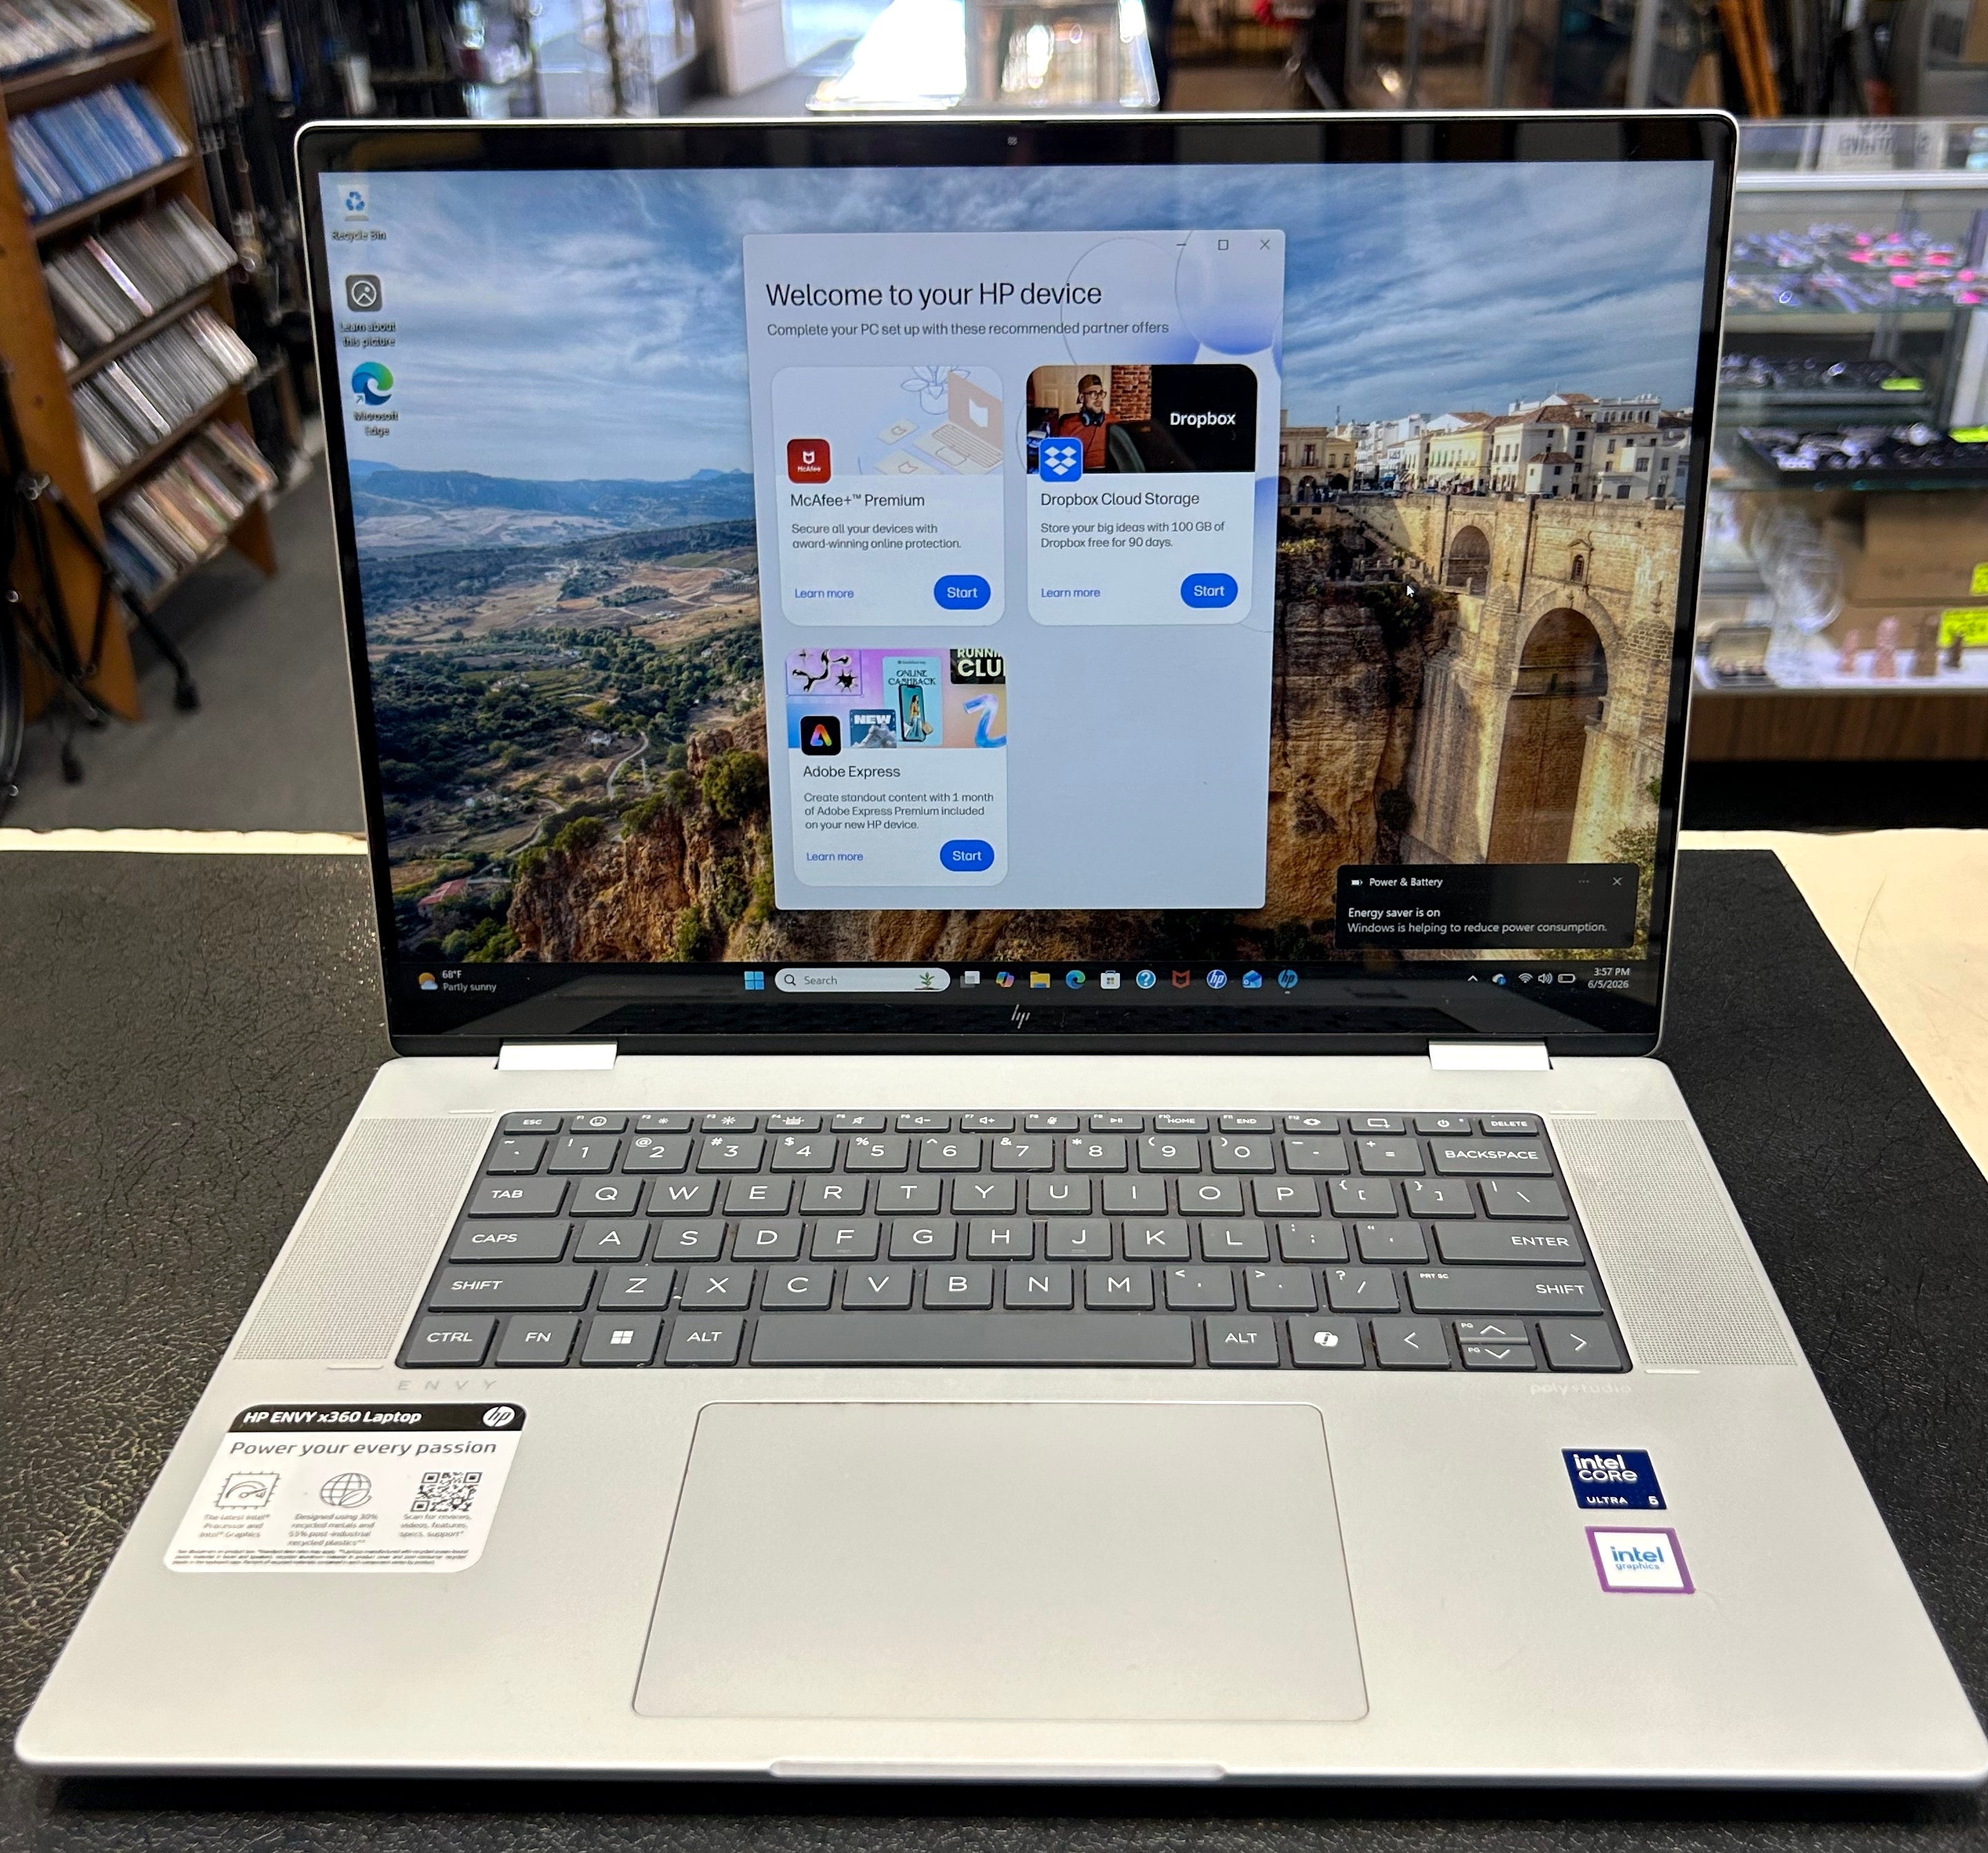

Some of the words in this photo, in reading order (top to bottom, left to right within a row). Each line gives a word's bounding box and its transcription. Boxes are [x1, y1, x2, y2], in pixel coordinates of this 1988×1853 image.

[766, 284, 882, 306] Welcome
[889, 285, 912, 305] to
[918, 288, 973, 310] your
[981, 283, 1014, 304] HP
[1021, 282, 1101, 304] device
[340, 323, 366, 333] Learn
[368, 323, 395, 332] about
[767, 324, 828, 337] Complete
[831, 326, 858, 337] your
[861, 324, 878, 335] PC
[882, 324, 900, 335] set
[904, 326, 920, 337] up
[923, 323, 947, 334] with
[952, 323, 986, 334] these
[989, 322, 1079, 334] recommended
[1083, 323, 1130, 335] partner
[1132, 322, 1169, 333] offers
[343, 337, 360, 347] this
[362, 337, 395, 349] picture
[353, 411, 398, 421] Microsoft
[1170, 411, 1236, 428] Dropbox
[365, 427, 389, 438] Edge
[865, 494, 924, 506] Premium
[1041, 493, 1098, 508] Dropbox
[1101, 493, 1141, 505] Cloud
[1145, 493, 1199, 507] Storage
[791, 524, 829, 533] Secure
[832, 524, 845, 533] all
[847, 526, 870, 536] your
[873, 524, 914, 533] devices
[916, 524, 938, 533] with
[1041, 523, 1070, 533] Store
[1072, 525, 1095, 534] your
[1098, 523, 1113, 535] big
[1116, 522, 1145, 532] ideas
[1148, 522, 1169, 531] with
[1172, 522, 1193, 531] 100
[1196, 522, 1212, 531] GB
[1214, 521, 1225, 531] of
[793, 539, 869, 551] award-winning
[871, 538, 903, 549] online
[905, 539, 961, 550] protection.
[1041, 538, 1085, 549] Dropbox
[1088, 538, 1109, 547] free
[1112, 538, 1126, 547] for
[1129, 538, 1143, 547] 90
[1145, 538, 1172, 549] days.
[795, 589, 825, 598] Learn
[947, 587, 978, 598] Start
[1041, 589, 1071, 598] Learn
[1194, 585, 1225, 596] Start
[958, 659, 1005, 676] CLU
[854, 714, 891, 724] NEW
[804, 766, 845, 777] Adobe
[849, 766, 900, 779] Express
[804, 793, 838, 802] Create
[841, 793, 886, 802] standout
[889, 794, 927, 802] content
[929, 793, 950, 801] with
[953, 793, 958, 801] 1
[962, 793, 994, 801] month
[805, 807, 814, 815] of
[818, 806, 849, 815] Adobe
[852, 807, 892, 817] Express
[895, 807, 939, 815] Premium
[941, 806, 984, 815] included
[820, 823, 842, 831] your
[867, 820, 881, 828] HP
[884, 821, 918, 829] device.
[807, 852, 835, 861] Learn
[953, 851, 982, 861] Start
[1370, 878, 1397, 886] Power
[1400, 878, 1407, 886] &
[1411, 878, 1443, 888] Battery
[1349, 908, 1384, 919] Energy
[1416, 908, 1424, 917] is
[1348, 923, 1395, 932] Windows
[1398, 923, 1406, 932] is
[1408, 923, 1447, 934] helping
[1464, 923, 1499, 932] reduce
[1502, 925, 1535, 934] power
[1537, 922, 1606, 933] consumption.
[442, 970, 462, 979] 68°F
[1594, 968, 1613, 976] 3:57
[805, 976, 837, 985] Search
[1210, 970, 1224, 988] hp
[1588, 980, 1628, 988] 6/5/2026
[443, 983, 468, 992] Partly
[470, 984, 497, 992] sunny
[1445, 1150, 1538, 1159] BACKSPACE
[596, 1186, 618, 1200] Q
[669, 1186, 698, 1199] W
[749, 1186, 767, 1199] E
[472, 1233, 518, 1243] CAPS
[1512, 1237, 1569, 1246] ENTER
[451, 1280, 503, 1290] SHIFT
[1536, 1284, 1584, 1294] SHIFT
[427, 1333, 473, 1342] CTRL
[525, 1332, 552, 1342] FN
[687, 1331, 722, 1342] ALT
[1226, 1333, 1257, 1343] ALT
[243, 1412, 269, 1423] HP
[270, 1411, 317, 1423] ENVY
[317, 1411, 361, 1422] x360
[363, 1411, 422, 1424] Laptop
[230, 1442, 297, 1454] Power
[300, 1444, 349, 1456] your
[353, 1444, 412, 1456] every
[415, 1441, 496, 1456] passion
[1573, 1454, 1625, 1469] intel
[1586, 1496, 1628, 1504] ULTRA
[1611, 1546, 1664, 1562] intel
